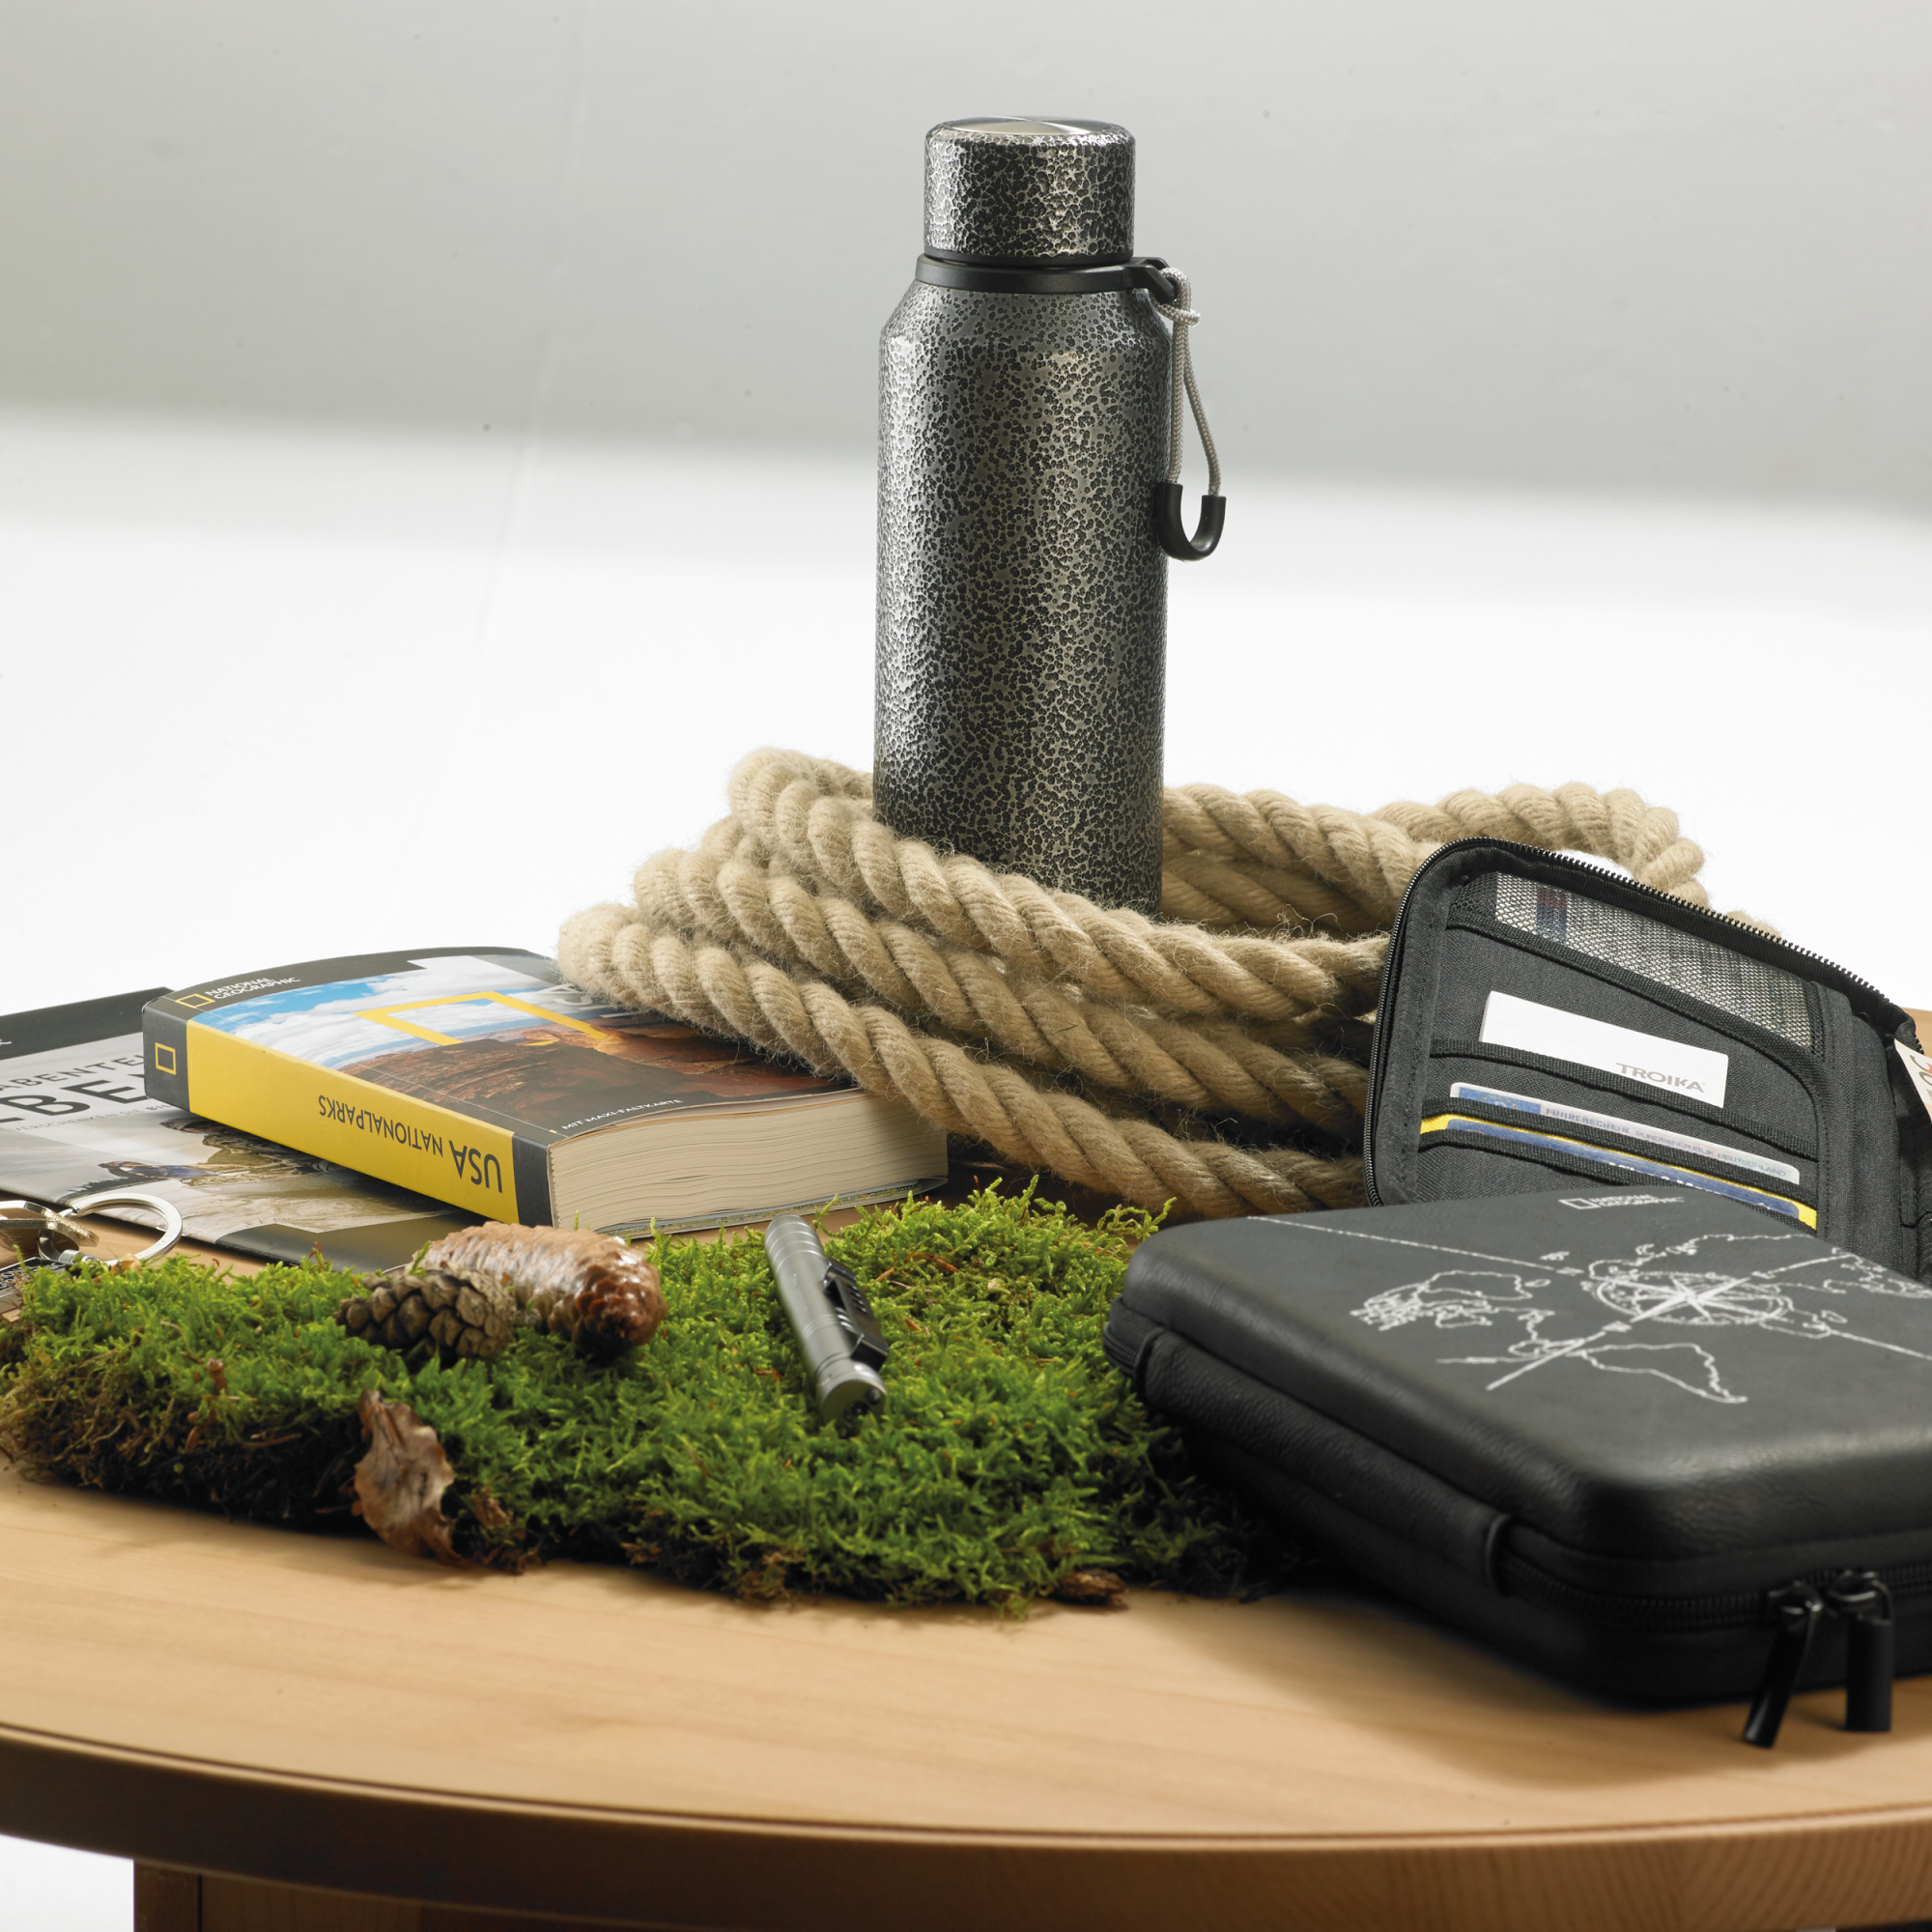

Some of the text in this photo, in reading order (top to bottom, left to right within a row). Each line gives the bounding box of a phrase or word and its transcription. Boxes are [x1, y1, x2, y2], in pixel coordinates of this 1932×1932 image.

[205, 978, 275, 996] NATIONAL
[213, 978, 301, 999] GEOGRAPHIC
[0, 1054, 145, 1091] ABENTE
[1616, 1063, 1705, 1093] TROIKA
[561, 1121, 583, 1129] MIT
[318, 1094, 503, 1193] USA NATIONALPARKS
[1546, 1108, 1630, 1134] FÜHRERSCHEIN
[1718, 1152, 1786, 1178] DEUTSCHLAND
